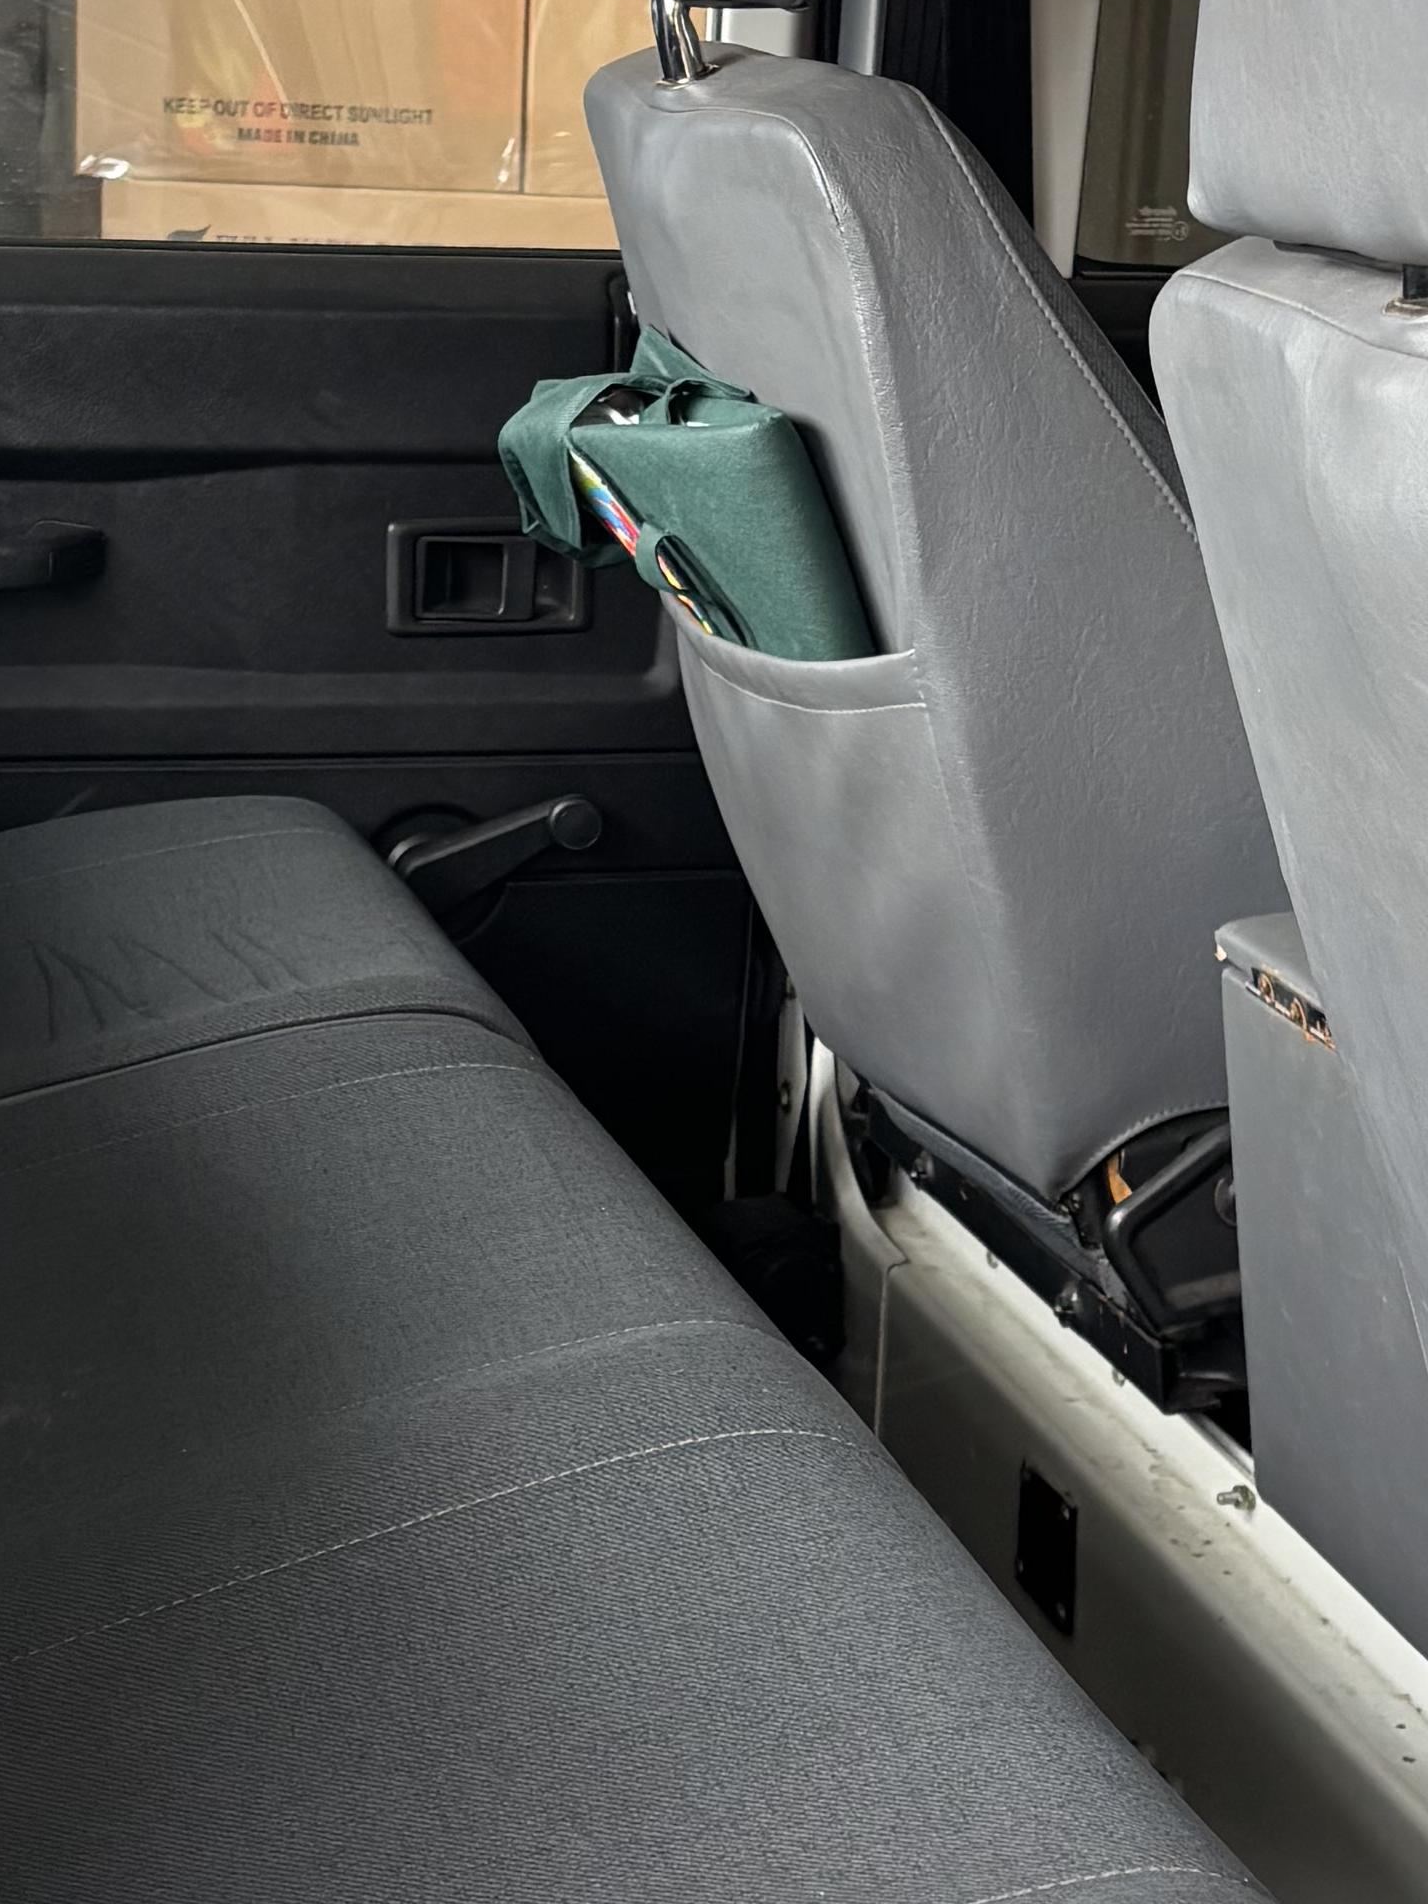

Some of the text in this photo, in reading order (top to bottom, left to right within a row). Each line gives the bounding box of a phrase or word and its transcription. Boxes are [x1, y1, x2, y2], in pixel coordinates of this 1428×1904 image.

[164, 97, 433, 125] KEEP OUT OF DIRECT SUNLIGHT
[237, 128, 360, 146] MADE IN CHINA
